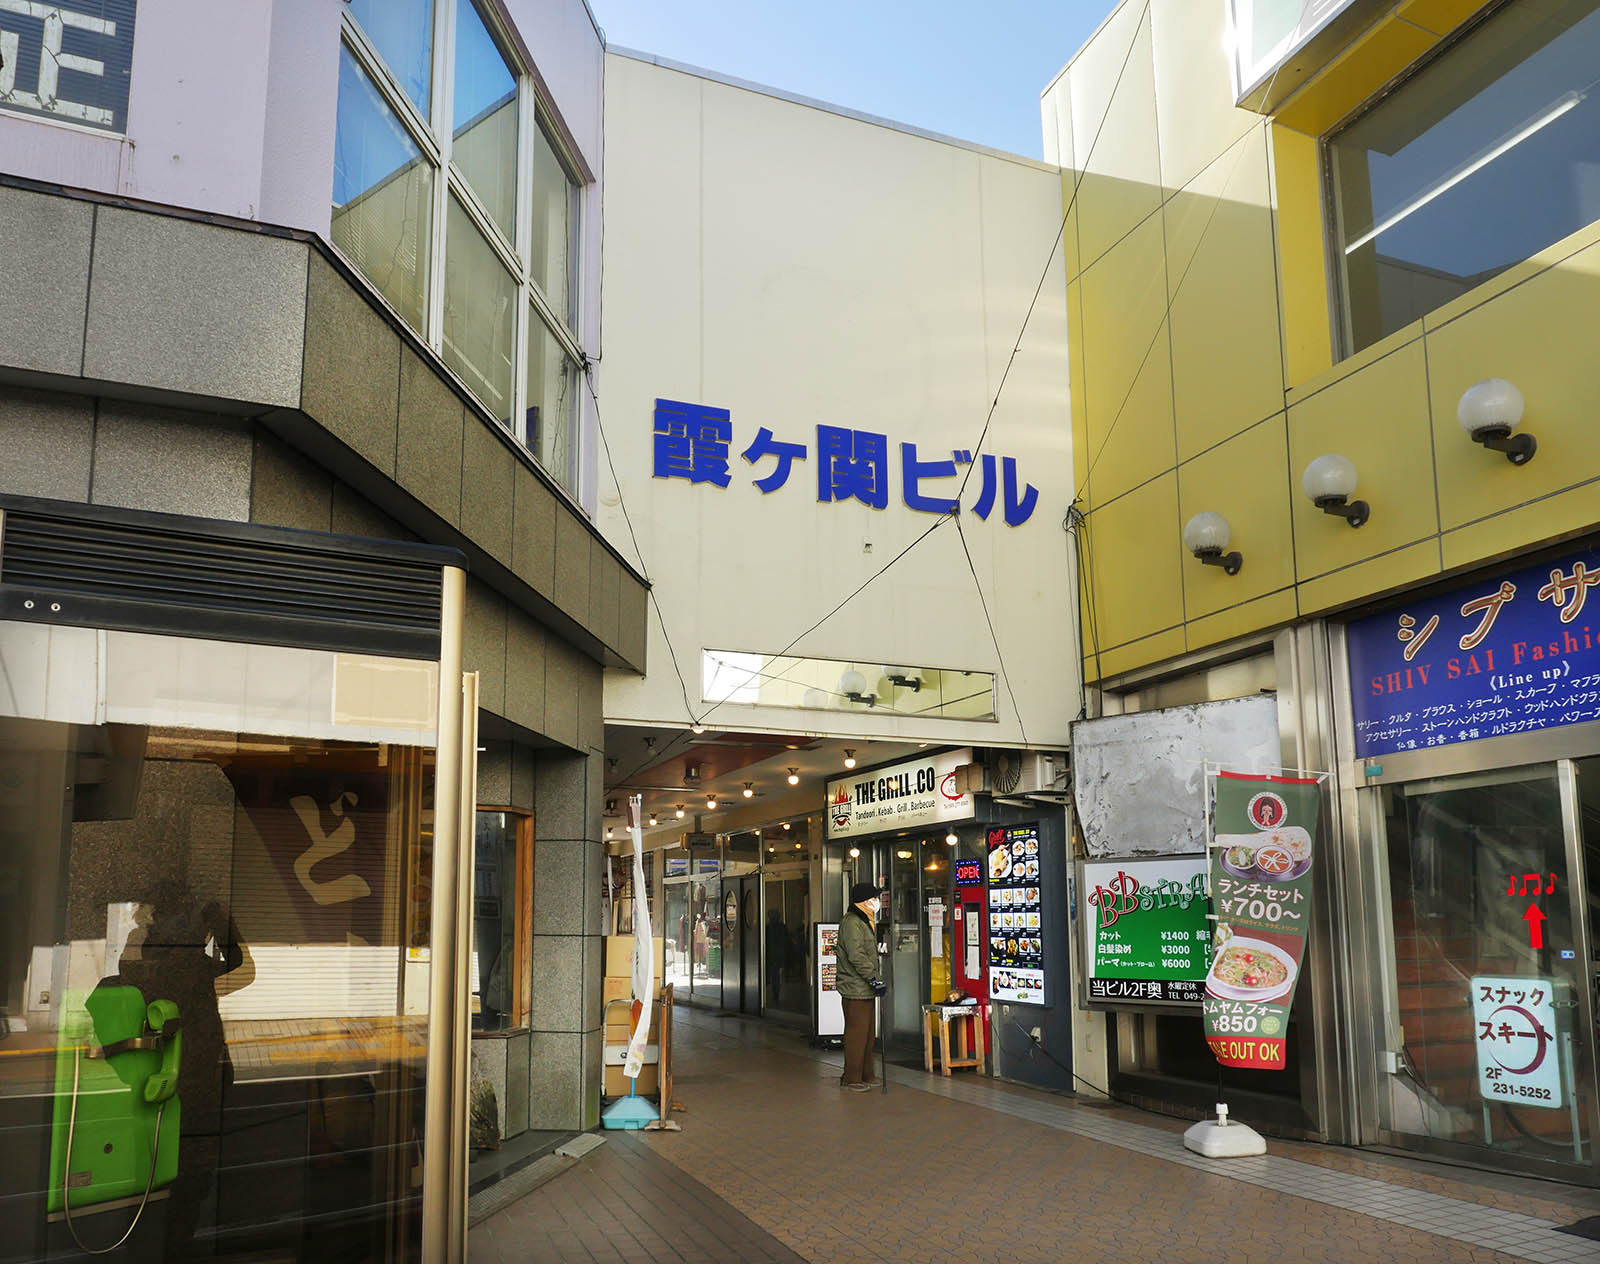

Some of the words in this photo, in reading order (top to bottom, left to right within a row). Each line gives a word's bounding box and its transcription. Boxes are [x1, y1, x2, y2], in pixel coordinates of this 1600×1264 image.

[1370, 664, 1431, 697] SHIV
[1447, 649, 1496, 680] SAI
[1513, 626, 1600, 666] Fashi
[855, 780, 876, 806] THE
[878, 772, 911, 801] GRILL
[878, 805, 894, 816] Kebab
[910, 799, 936, 811] Barbecue
[957, 865, 980, 880] OPEN
[1218, 879, 1305, 905] ランチセット
[1099, 931, 1121, 941] カット
[1161, 931, 1190, 941] ¥1400
[1098, 944, 1132, 954] 白髪染め
[1161, 945, 1190, 954] ¥3000
[1161, 959, 1191, 968] ¥6000
[1092, 980, 1162, 999] 当ビル2F奥
[1168, 991, 1180, 1000] TEL
[1480, 986, 1545, 1006] スナック
[1202, 1001, 1284, 1016] トムヤムフォー
[1212, 1015, 1258, 1033] ¥850
[1479, 1022, 1554, 1044] スキート
[1230, 1041, 1257, 1060] OUT
[1259, 1042, 1281, 1062] OK
[1485, 1067, 1503, 1080] 2F
[1493, 1082, 1552, 1100] 231-5252
